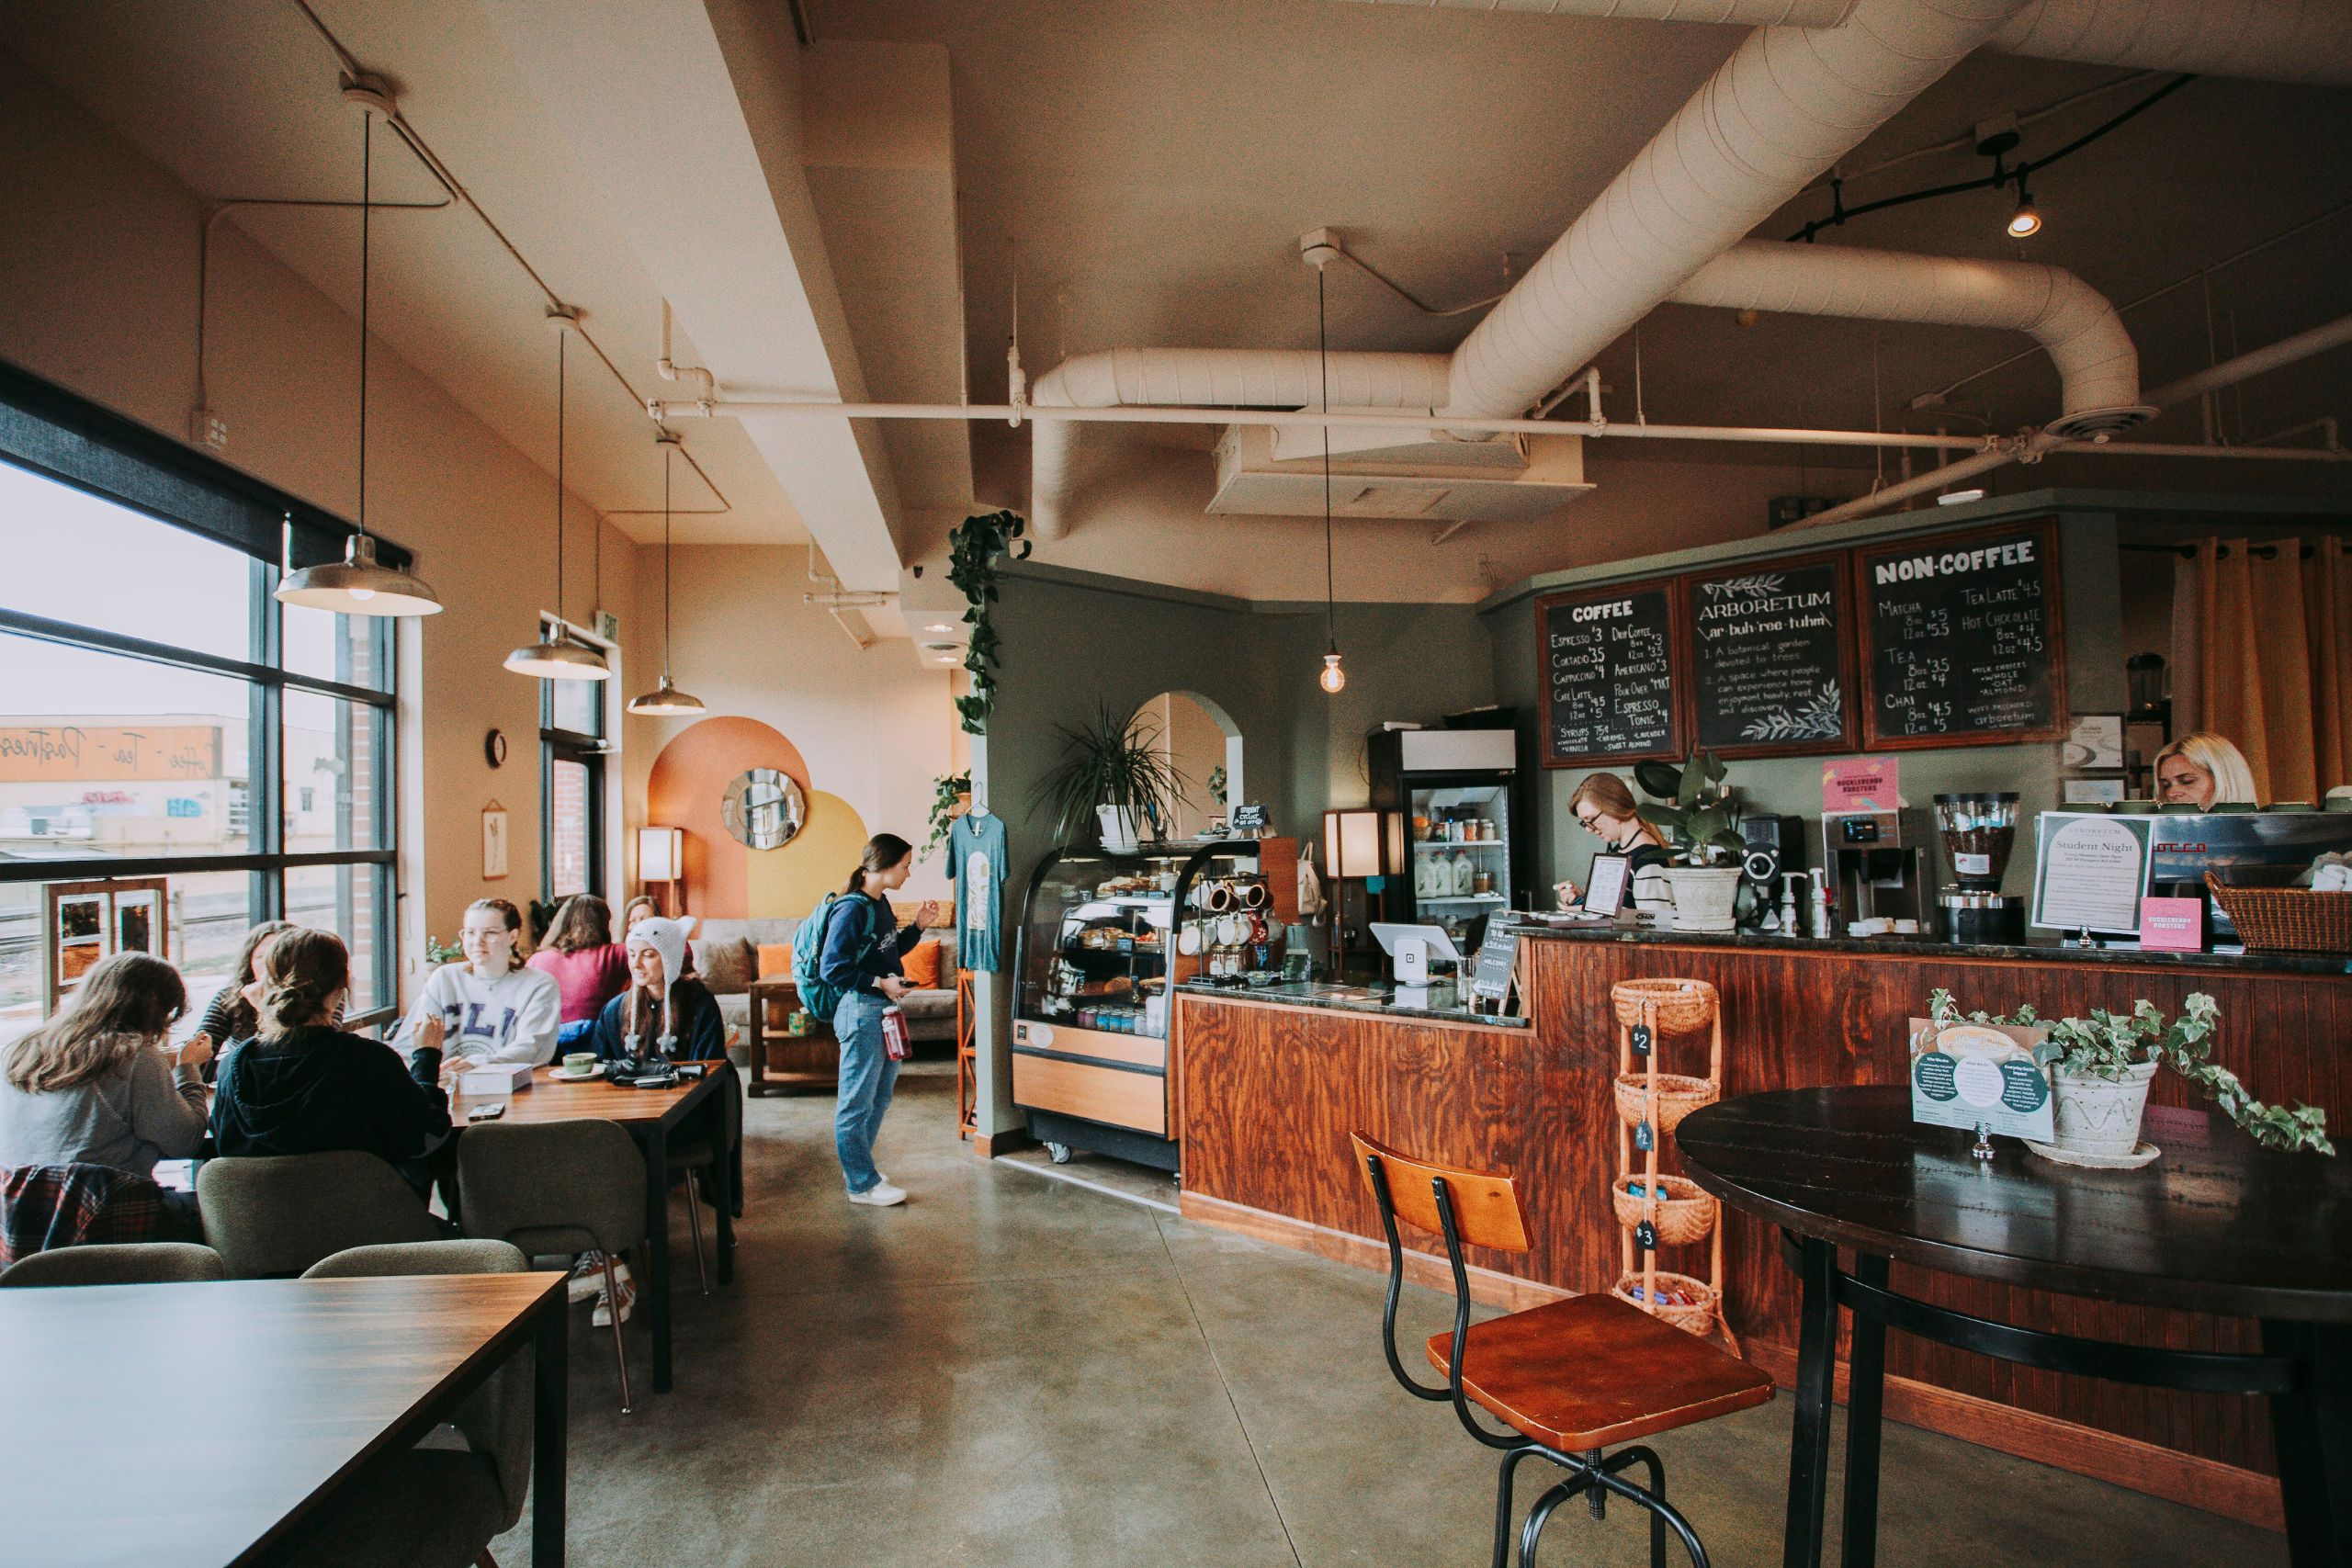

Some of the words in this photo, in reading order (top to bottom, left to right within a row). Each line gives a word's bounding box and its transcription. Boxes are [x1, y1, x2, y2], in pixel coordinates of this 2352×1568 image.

[1961, 589, 1984, 605] TEA
[1986, 587, 2018, 603] LATTE
[1572, 600, 1633, 623] COFFEE
[1700, 592, 1830, 621] ARBORETUM
[1879, 601, 1922, 617] MATCHA
[1931, 608, 1948, 622] $5
[1962, 616, 1981, 630] HOT
[1985, 608, 2041, 626] CHOCOLATE
[1628, 624, 1651, 638] COFFEE
[1551, 634, 1590, 648] ESPRESSO
[1715, 647, 1724, 657] A
[1727, 642, 1770, 655] botanical
[1778, 638, 1810, 653] garden
[1553, 654, 1589, 668] CORTADO
[1714, 657, 1750, 668] devoted
[1757, 655, 1766, 663] to
[1772, 652, 1800, 661] trees
[1885, 648, 1917, 664] TEA
[1614, 662, 1656, 677] AMERICANO
[1730, 672, 1756, 683] space
[1761, 669, 1788, 678] where
[1792, 665, 1820, 676] people
[1553, 671, 1595, 684] CAPPUCCINO
[1614, 683, 1630, 697] POUR
[1631, 682, 1648, 694] OVER
[1737, 682, 1787, 693] experience
[1614, 698, 1658, 715] ESPRESSO
[1885, 694, 1914, 708] CHAI
[1627, 714, 1655, 726] TONIC
[1975, 712, 2034, 726] arboretum
[1561, 728, 1589, 738] SYRUPS
[2056, 840, 2098, 850] Student
[2102, 842, 2133, 853] Night
[1634, 1032, 1647, 1049] $2
[1638, 1126, 1648, 1145] $2
[1636, 1226, 1653, 1245] $3
